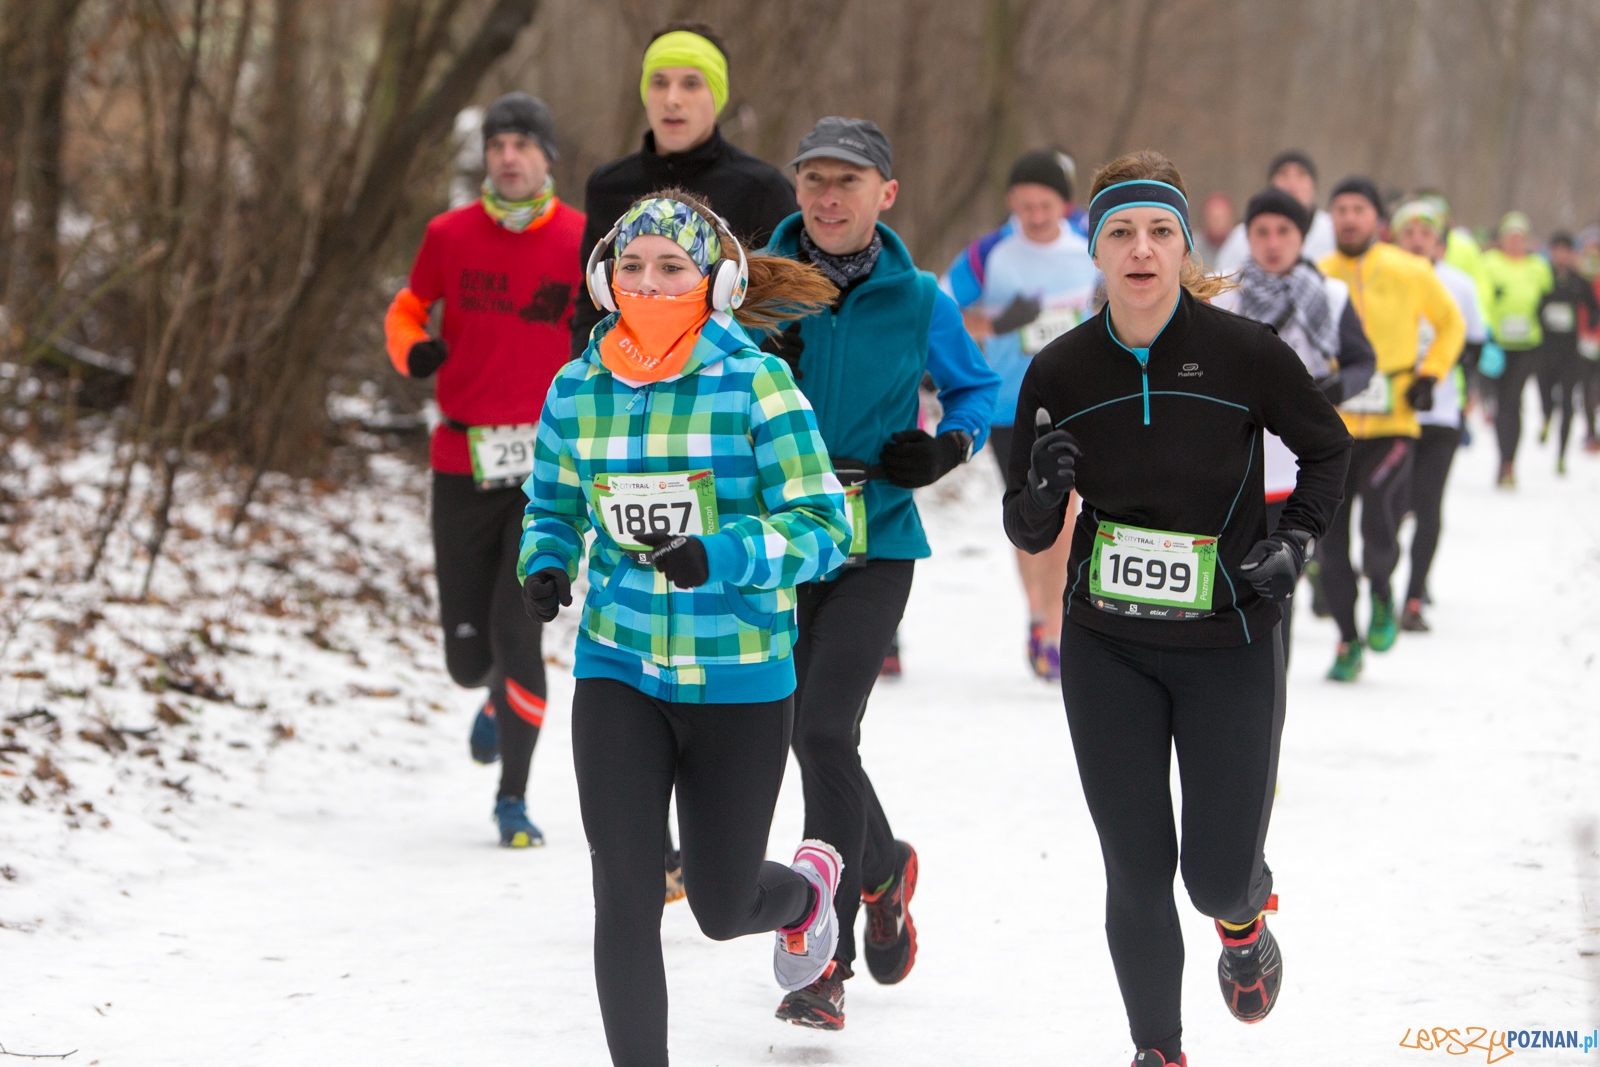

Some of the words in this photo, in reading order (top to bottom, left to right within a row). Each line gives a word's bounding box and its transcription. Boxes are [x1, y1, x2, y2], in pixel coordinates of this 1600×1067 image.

[492, 439, 536, 467] 29
[610, 501, 692, 535] 1867
[1109, 553, 1191, 593] 1699
[1200, 571, 1210, 601] Poznań
